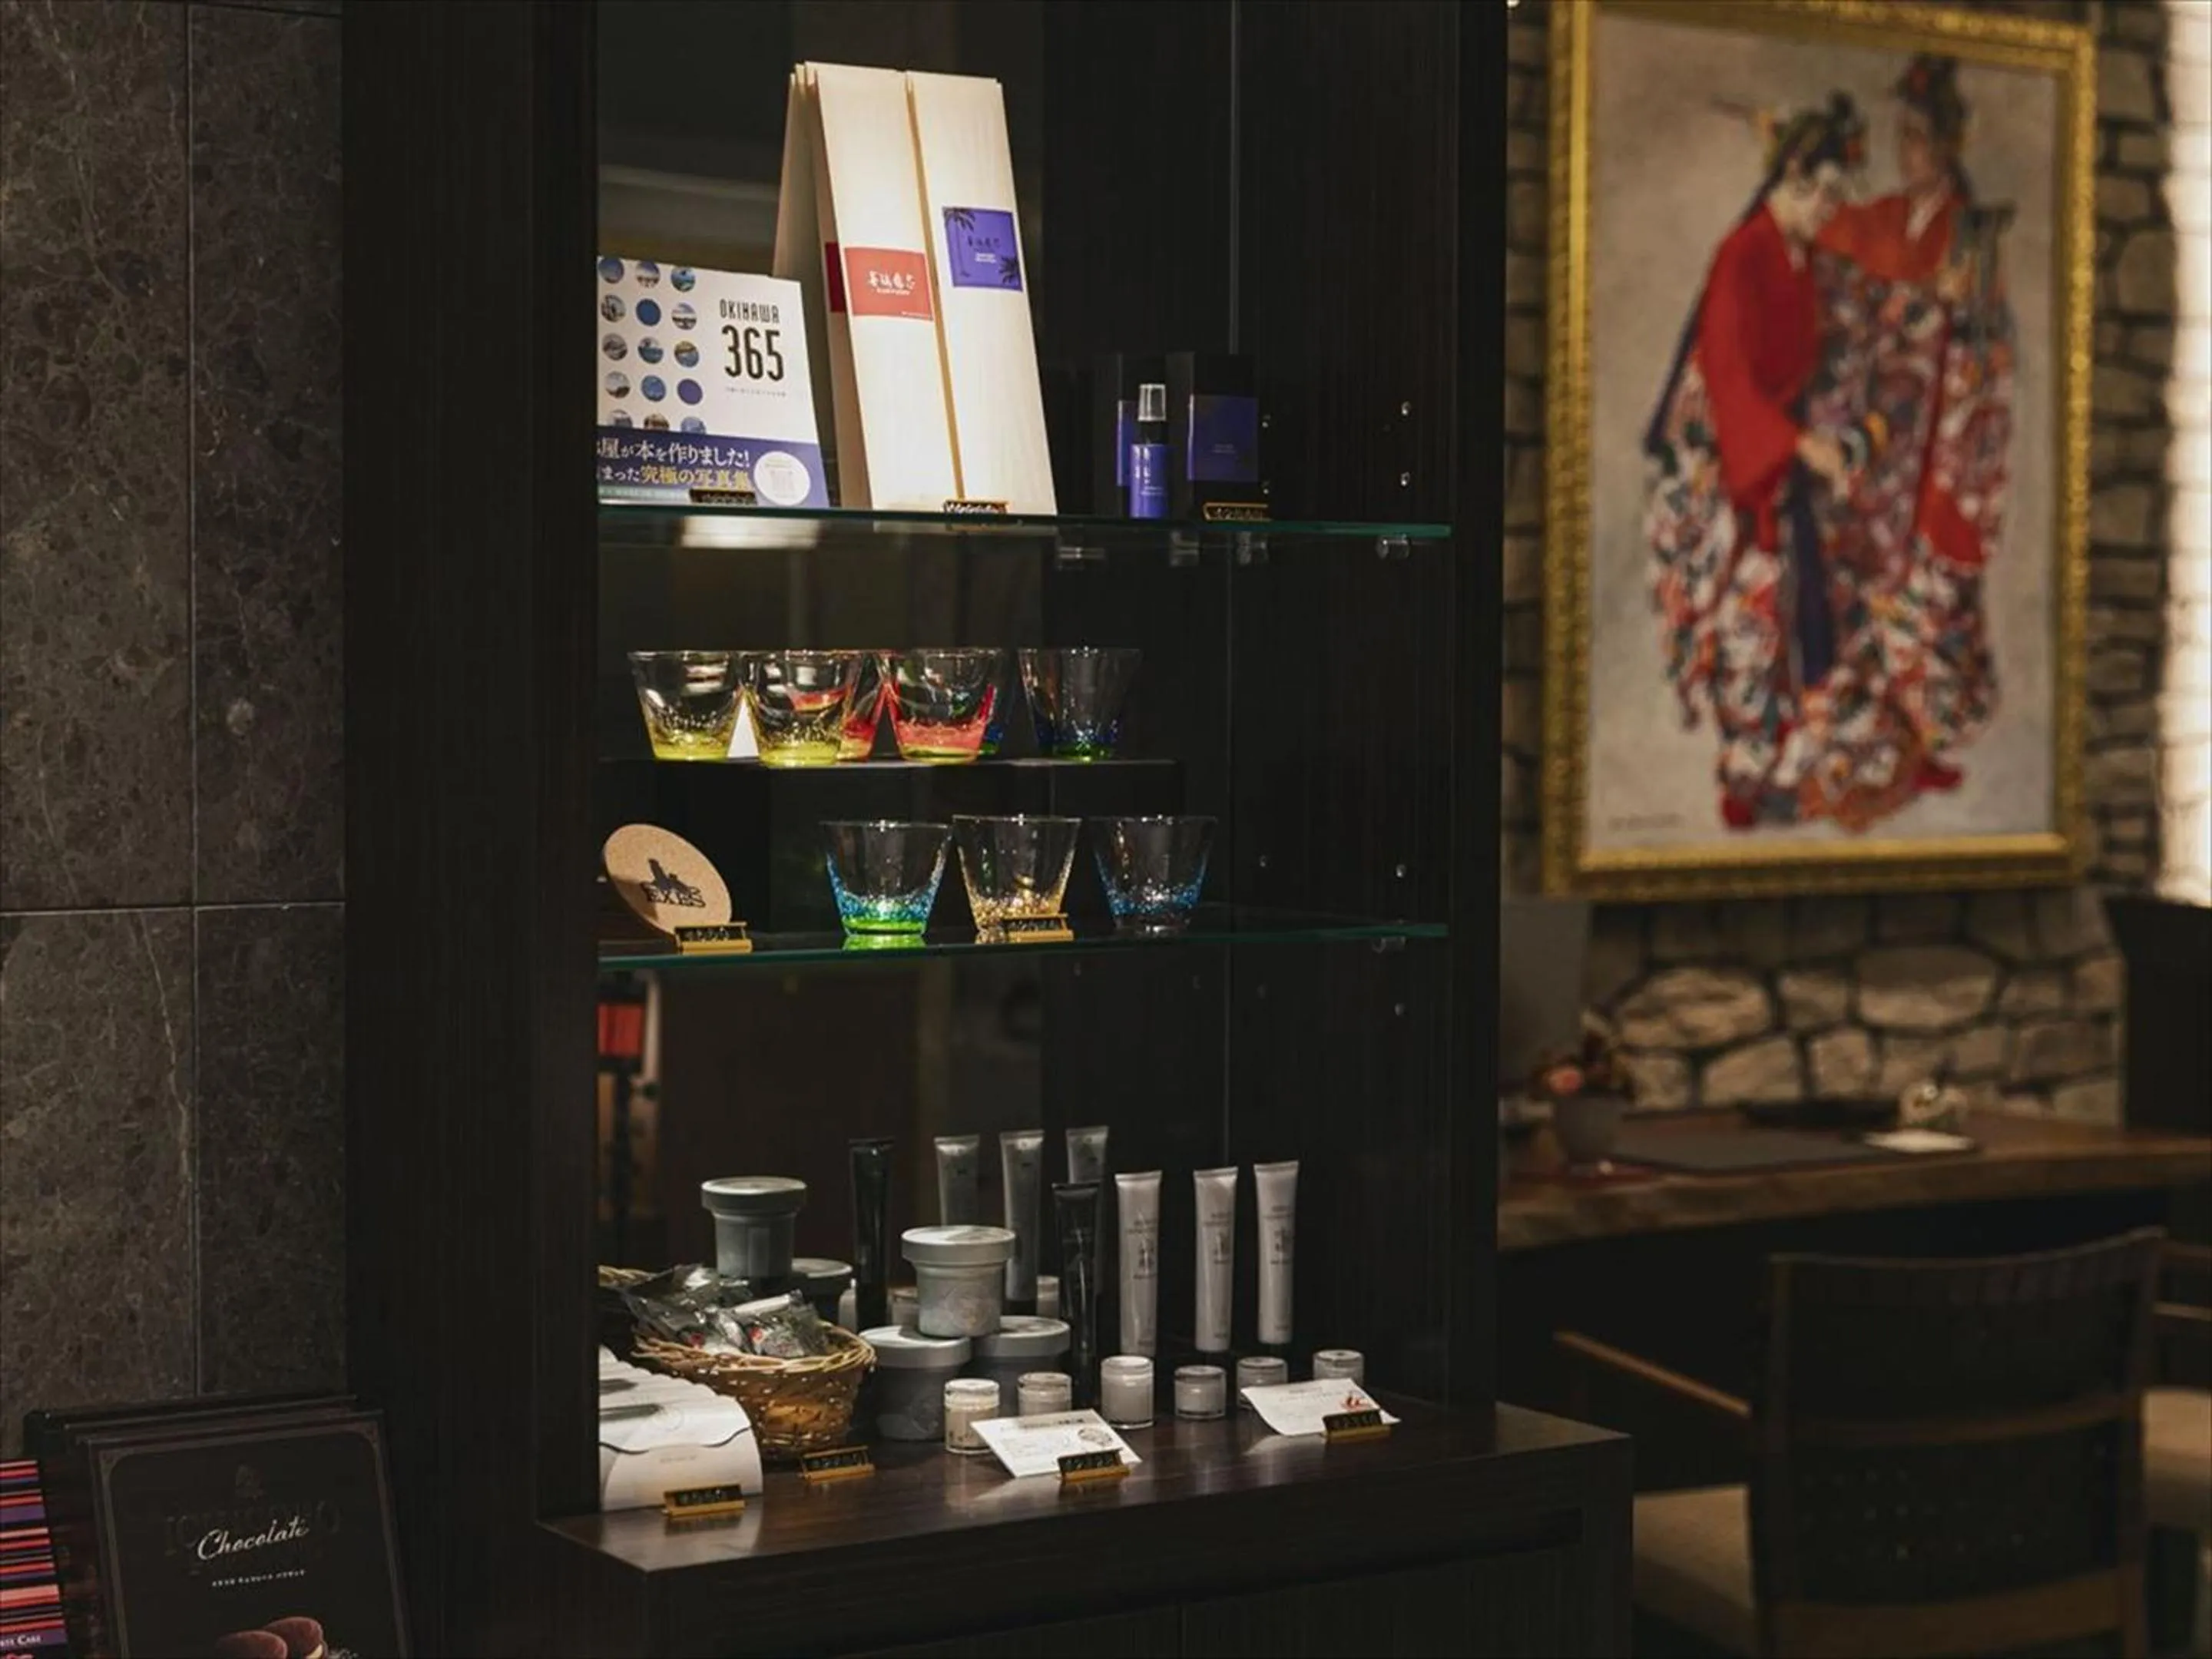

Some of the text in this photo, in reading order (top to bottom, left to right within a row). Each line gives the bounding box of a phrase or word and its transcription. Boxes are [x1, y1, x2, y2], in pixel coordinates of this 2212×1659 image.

[719, 298, 780, 323] OKINAWA
[721, 324, 784, 382] 365
[641, 881, 707, 909] EXES
